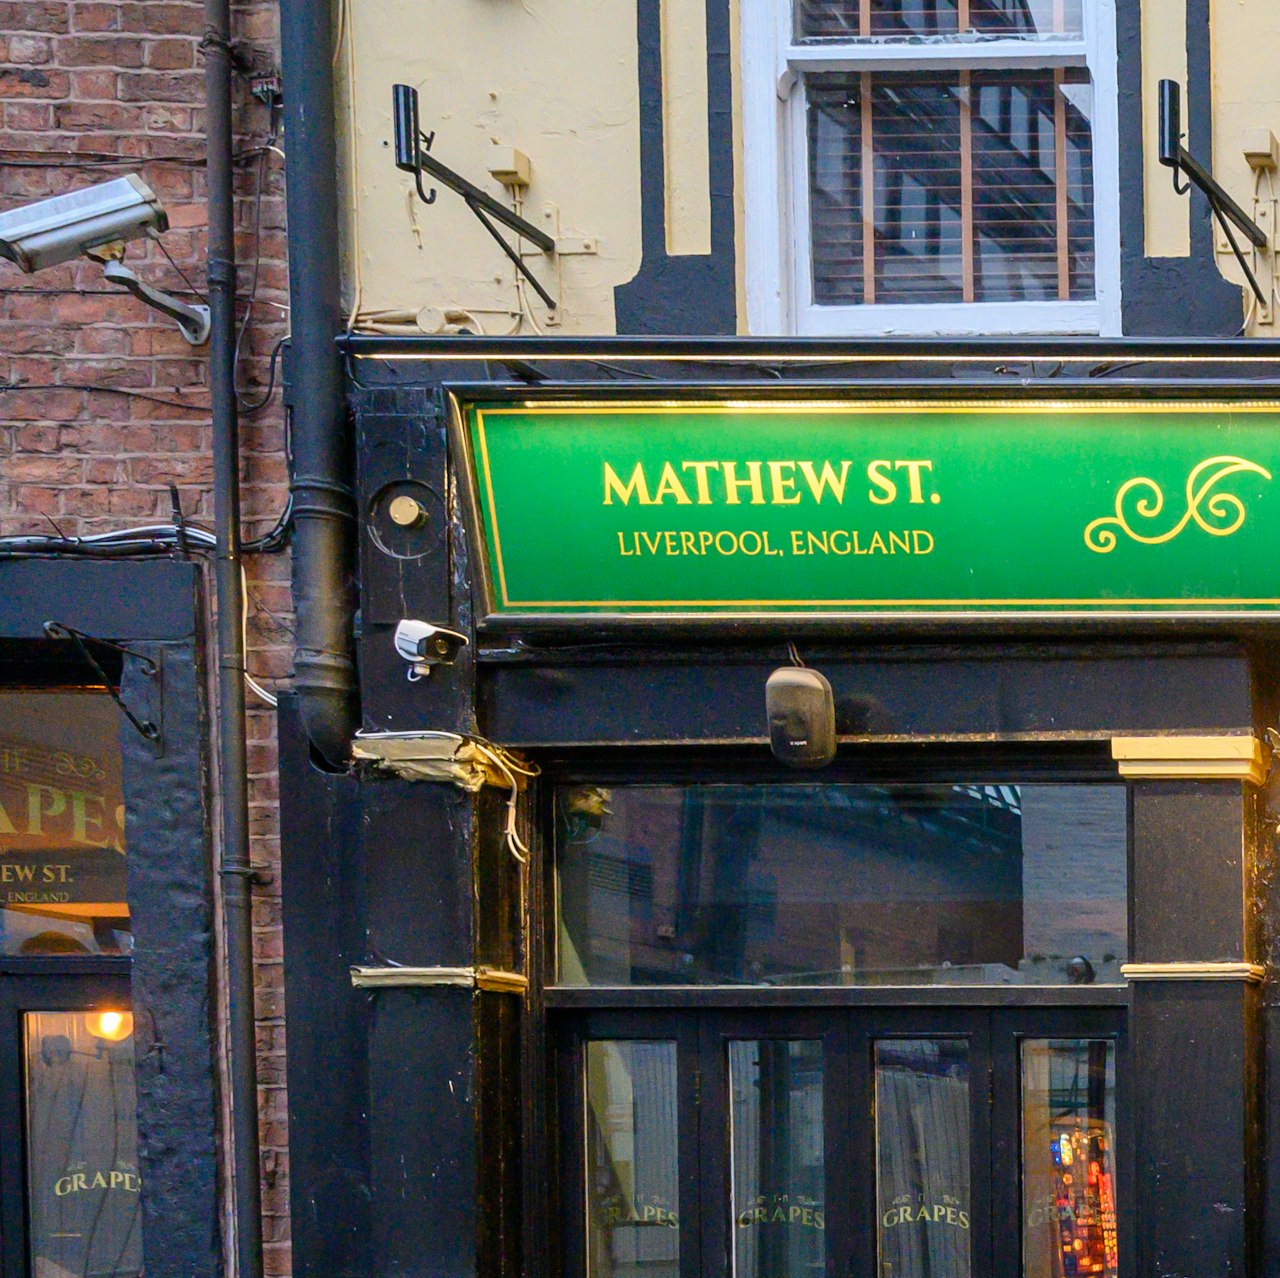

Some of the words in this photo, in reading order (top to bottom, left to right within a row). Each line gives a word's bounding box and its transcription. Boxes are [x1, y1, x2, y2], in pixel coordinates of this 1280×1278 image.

[603, 460, 853, 505] MATHEW
[867, 460, 940, 505] ST.
[618, 530, 784, 557] LIVERPOOL,
[791, 529, 935, 556] ENGLAND
[42, 863, 75, 884] ST.
[8, 891, 70, 903] ENGLAND
[738, 1206, 826, 1230] GRAPES
[882, 1204, 970, 1230] GRAPES
